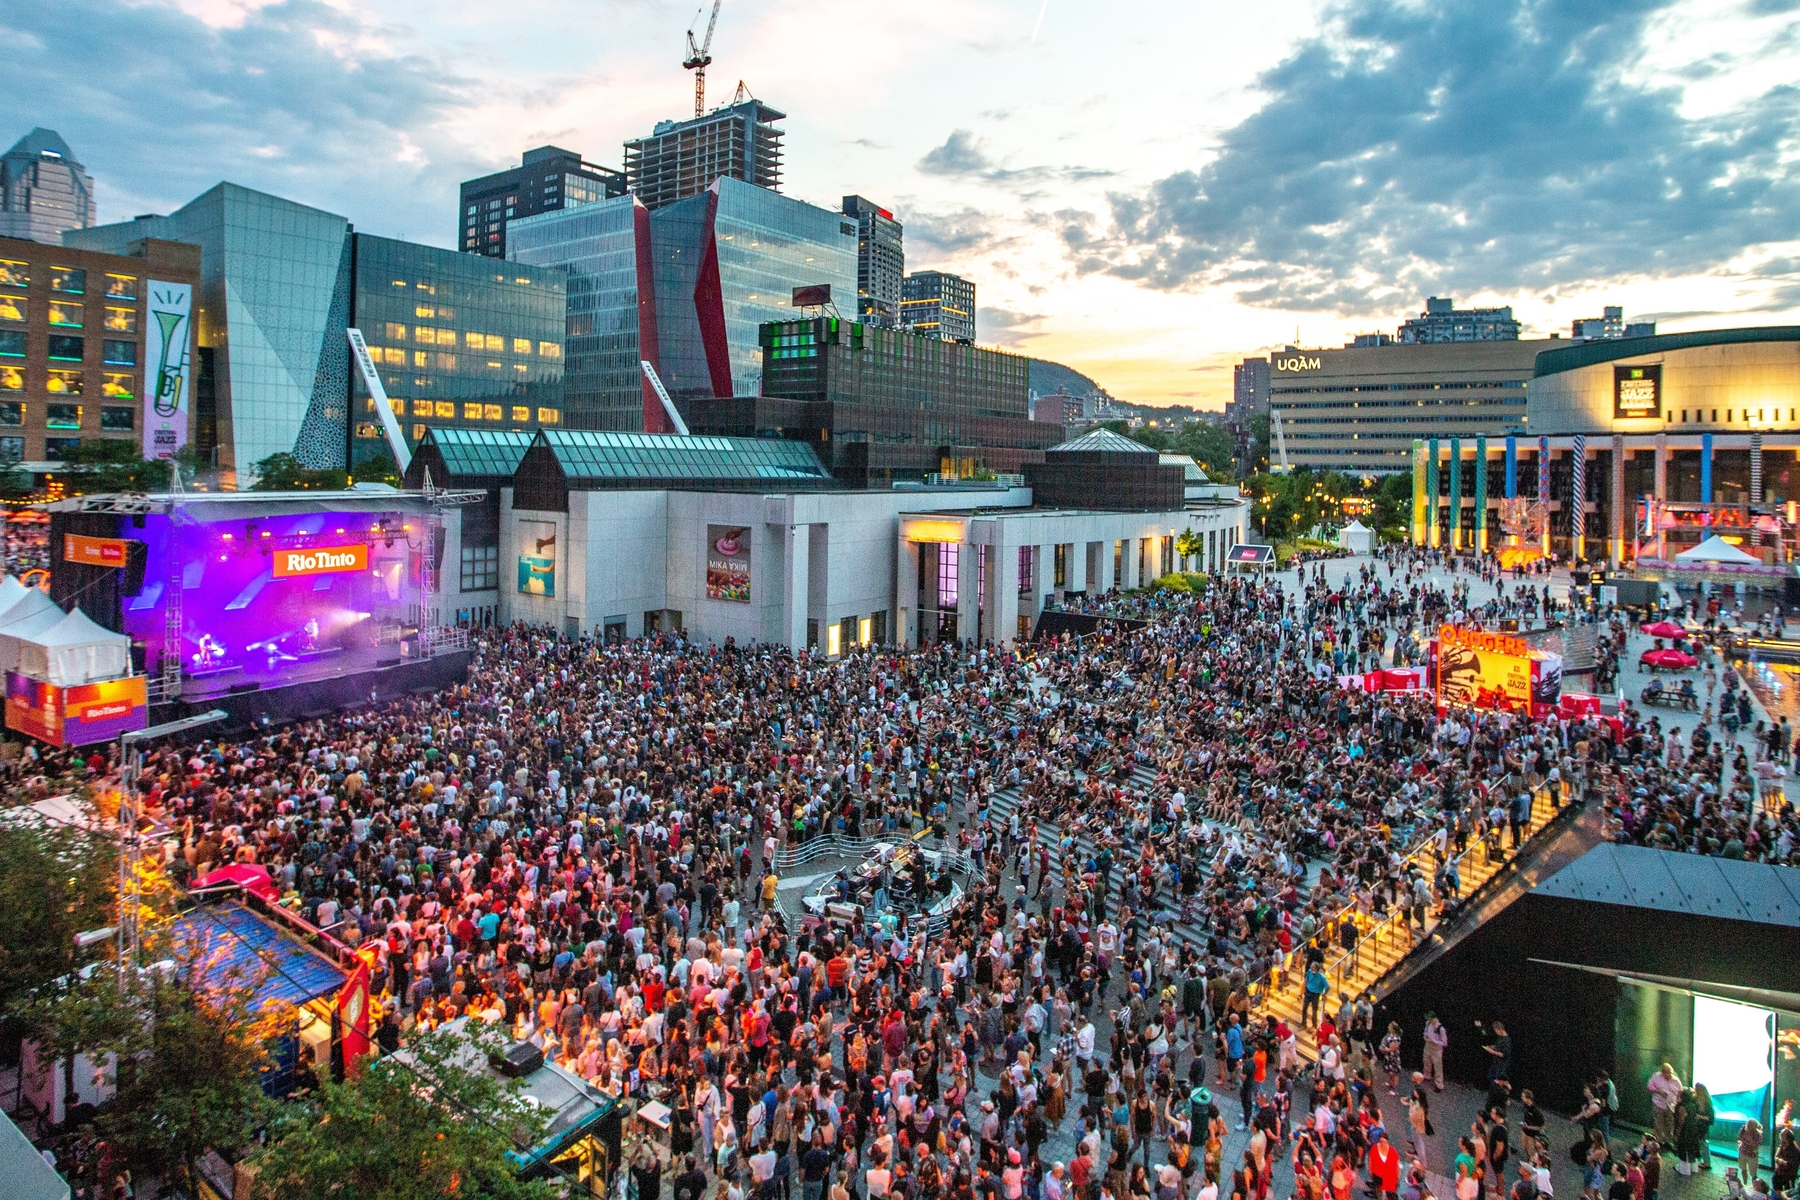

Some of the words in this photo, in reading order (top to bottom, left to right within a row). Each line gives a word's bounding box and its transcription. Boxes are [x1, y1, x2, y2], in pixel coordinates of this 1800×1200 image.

[1277, 355, 1321, 372] UQÀM
[1620, 388, 1655, 399] JAZZ
[154, 436, 176, 444] JAZZ
[709, 560, 728, 570] MIKA
[1458, 630, 1528, 656] ROGERS
[1508, 679, 1527, 691] JAZZ
